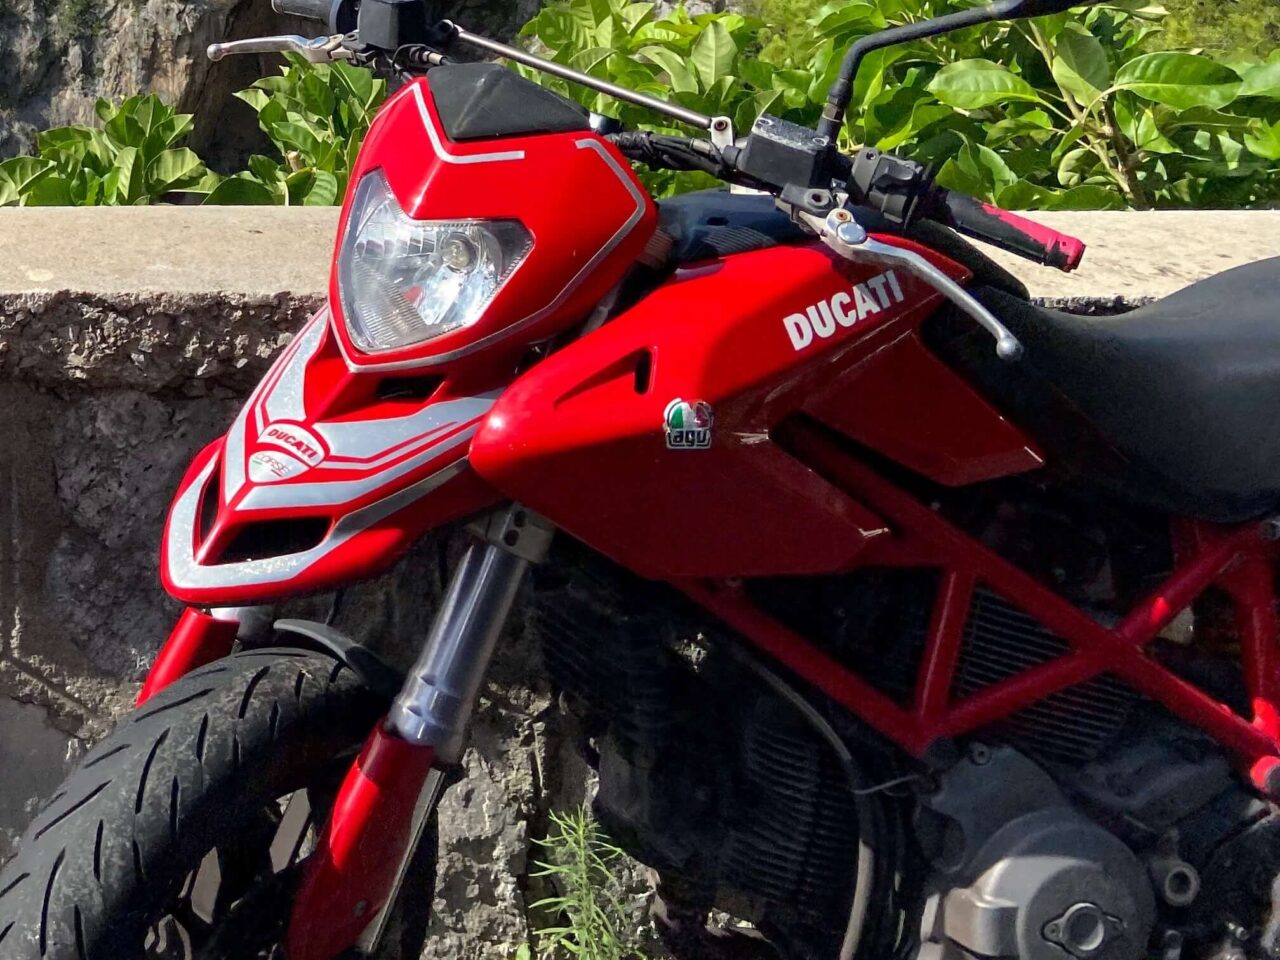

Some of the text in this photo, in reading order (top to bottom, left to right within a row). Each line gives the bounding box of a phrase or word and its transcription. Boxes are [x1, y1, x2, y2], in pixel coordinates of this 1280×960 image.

[783, 269, 904, 351] DUCATI
[267, 428, 318, 458] DUCATI
[254, 453, 291, 475] CORSE
